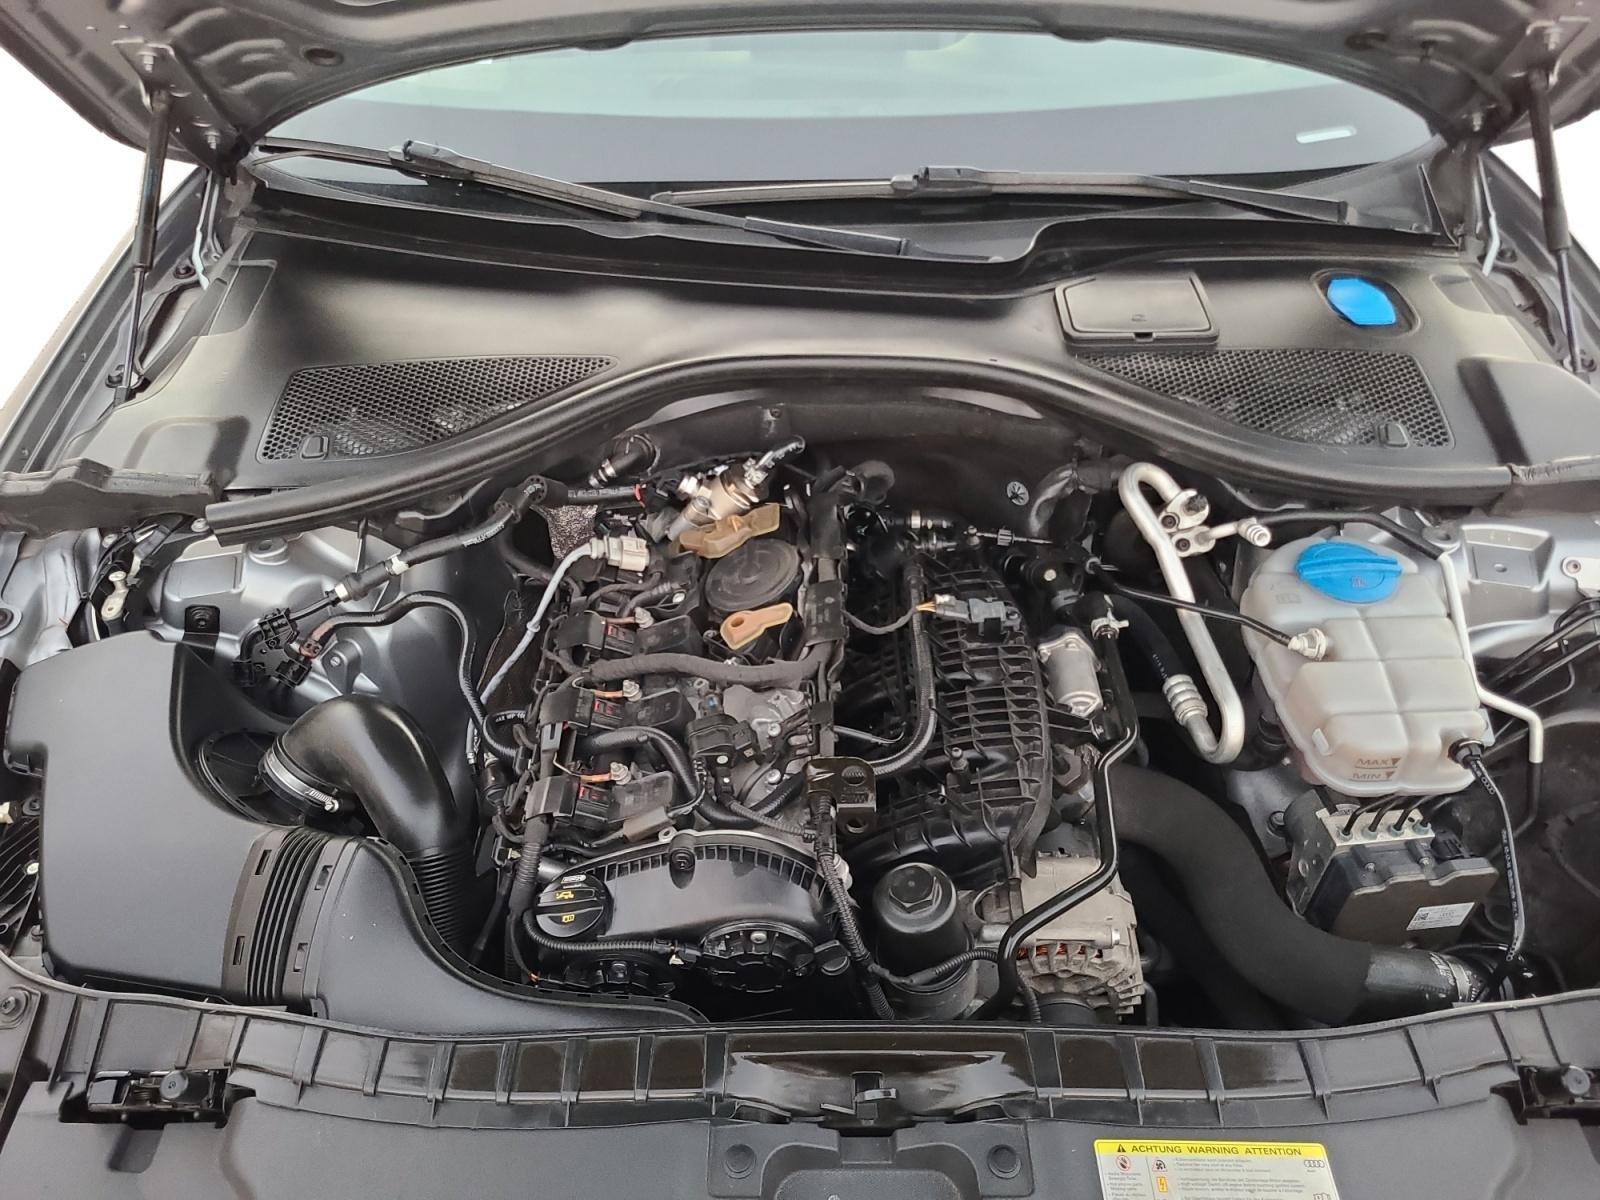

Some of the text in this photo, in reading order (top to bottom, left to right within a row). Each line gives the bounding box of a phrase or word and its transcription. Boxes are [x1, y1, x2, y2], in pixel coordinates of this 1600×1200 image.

[1356, 758, 1388, 766] MAX
[1131, 1145, 1302, 1156] ACHTUNG WARNING ATTENTION
